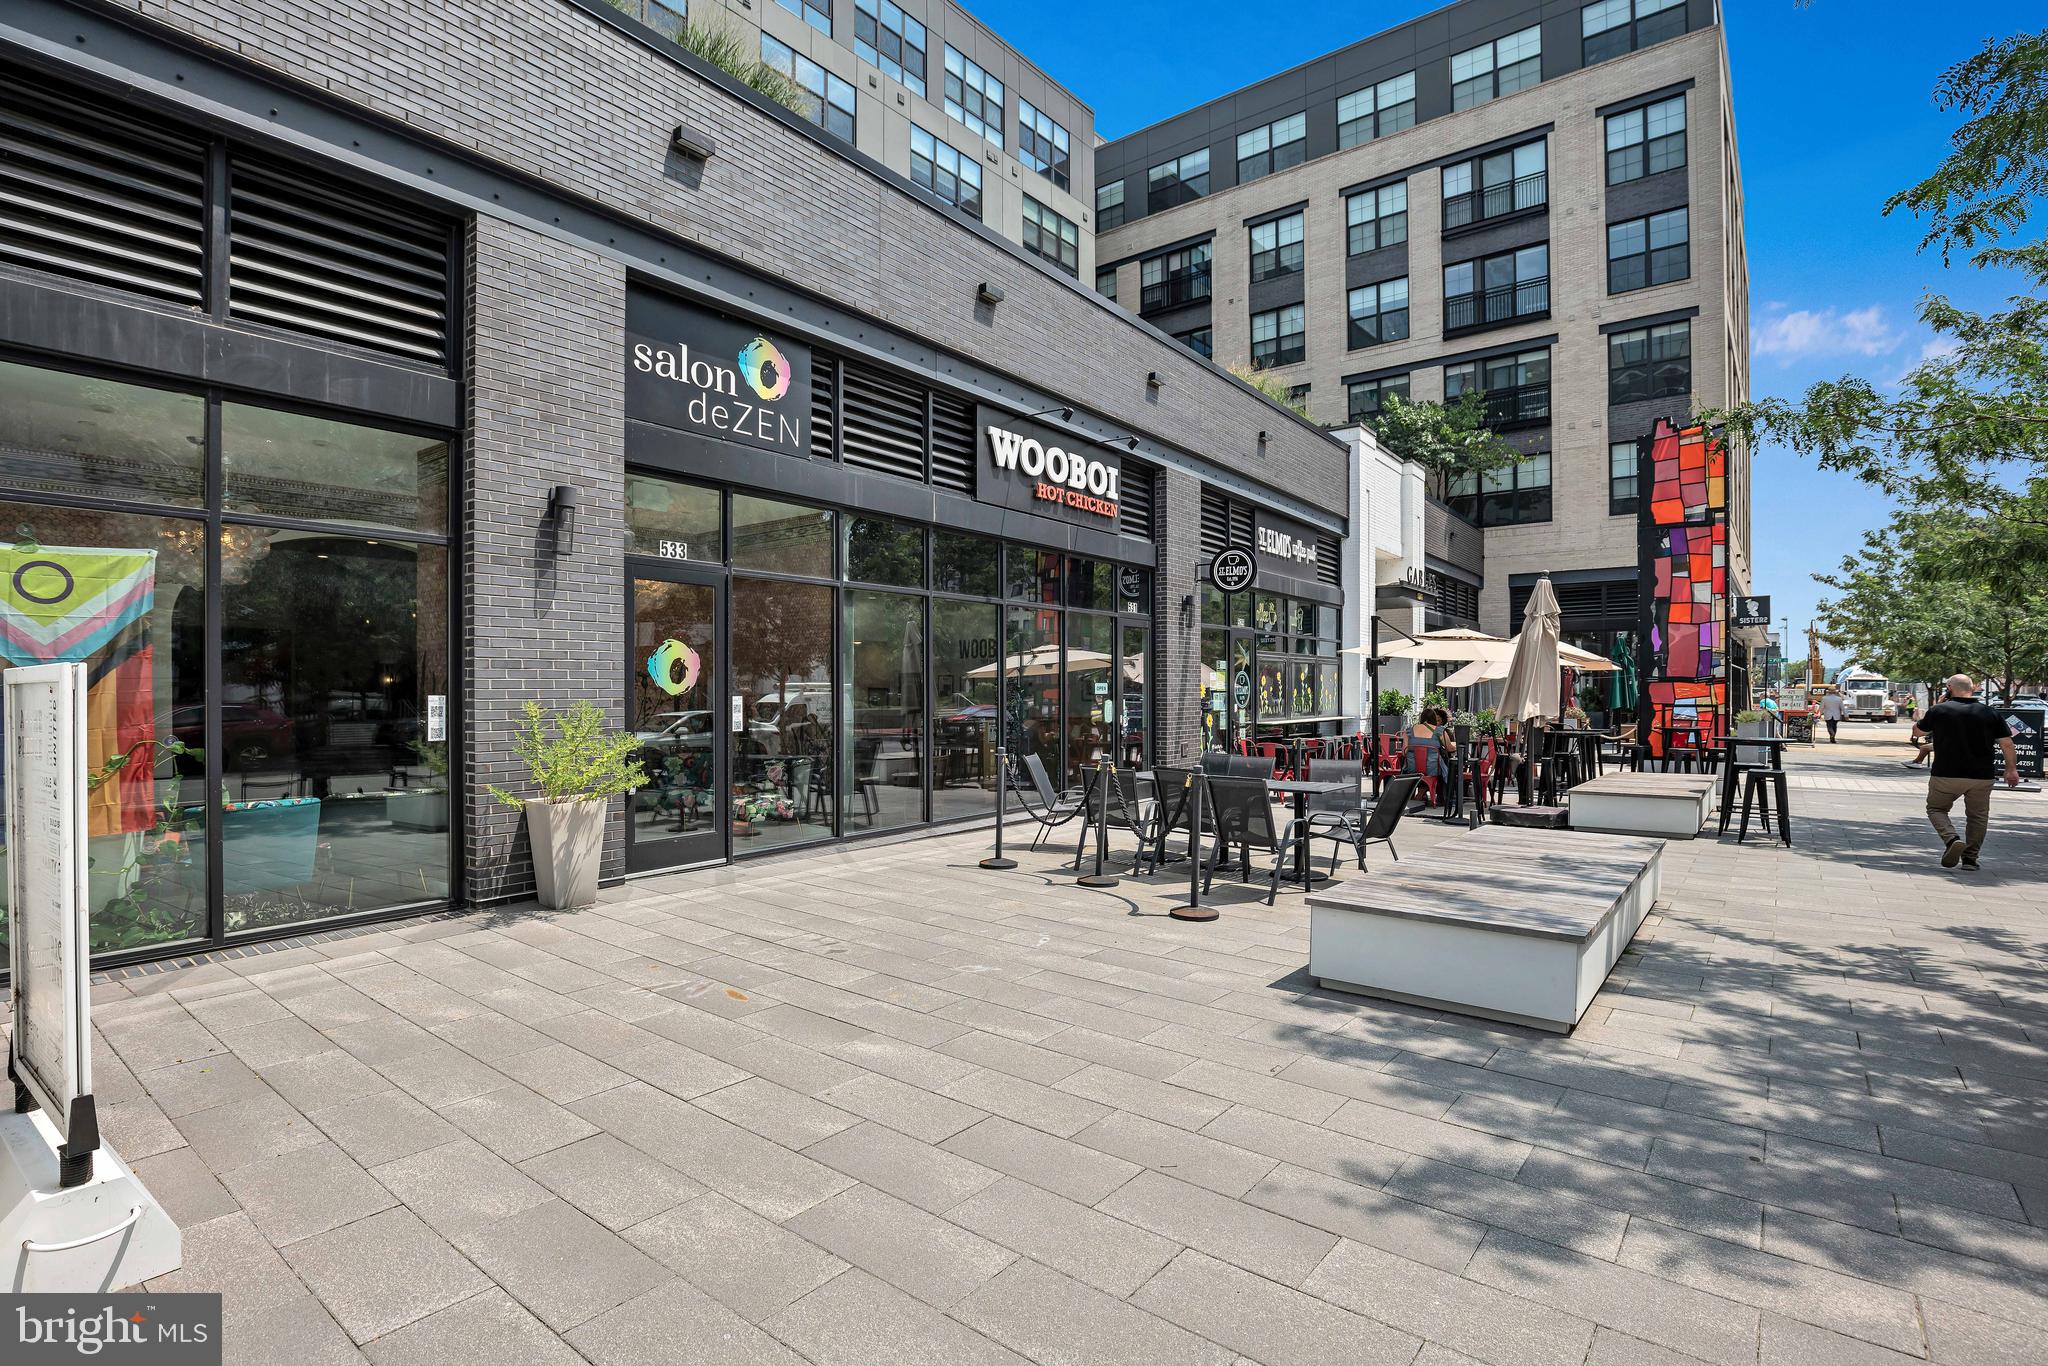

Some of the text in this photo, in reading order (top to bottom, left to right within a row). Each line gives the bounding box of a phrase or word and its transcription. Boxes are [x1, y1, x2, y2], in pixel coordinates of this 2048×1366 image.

[633, 342, 738, 397] salon
[688, 392, 800, 448] deZEN
[987, 425, 1119, 500] WOOBOI
[1036, 481, 1118, 518] HOT CHICKEN
[660, 541, 687, 559] 533
[1127, 602, 1138, 613] 531
